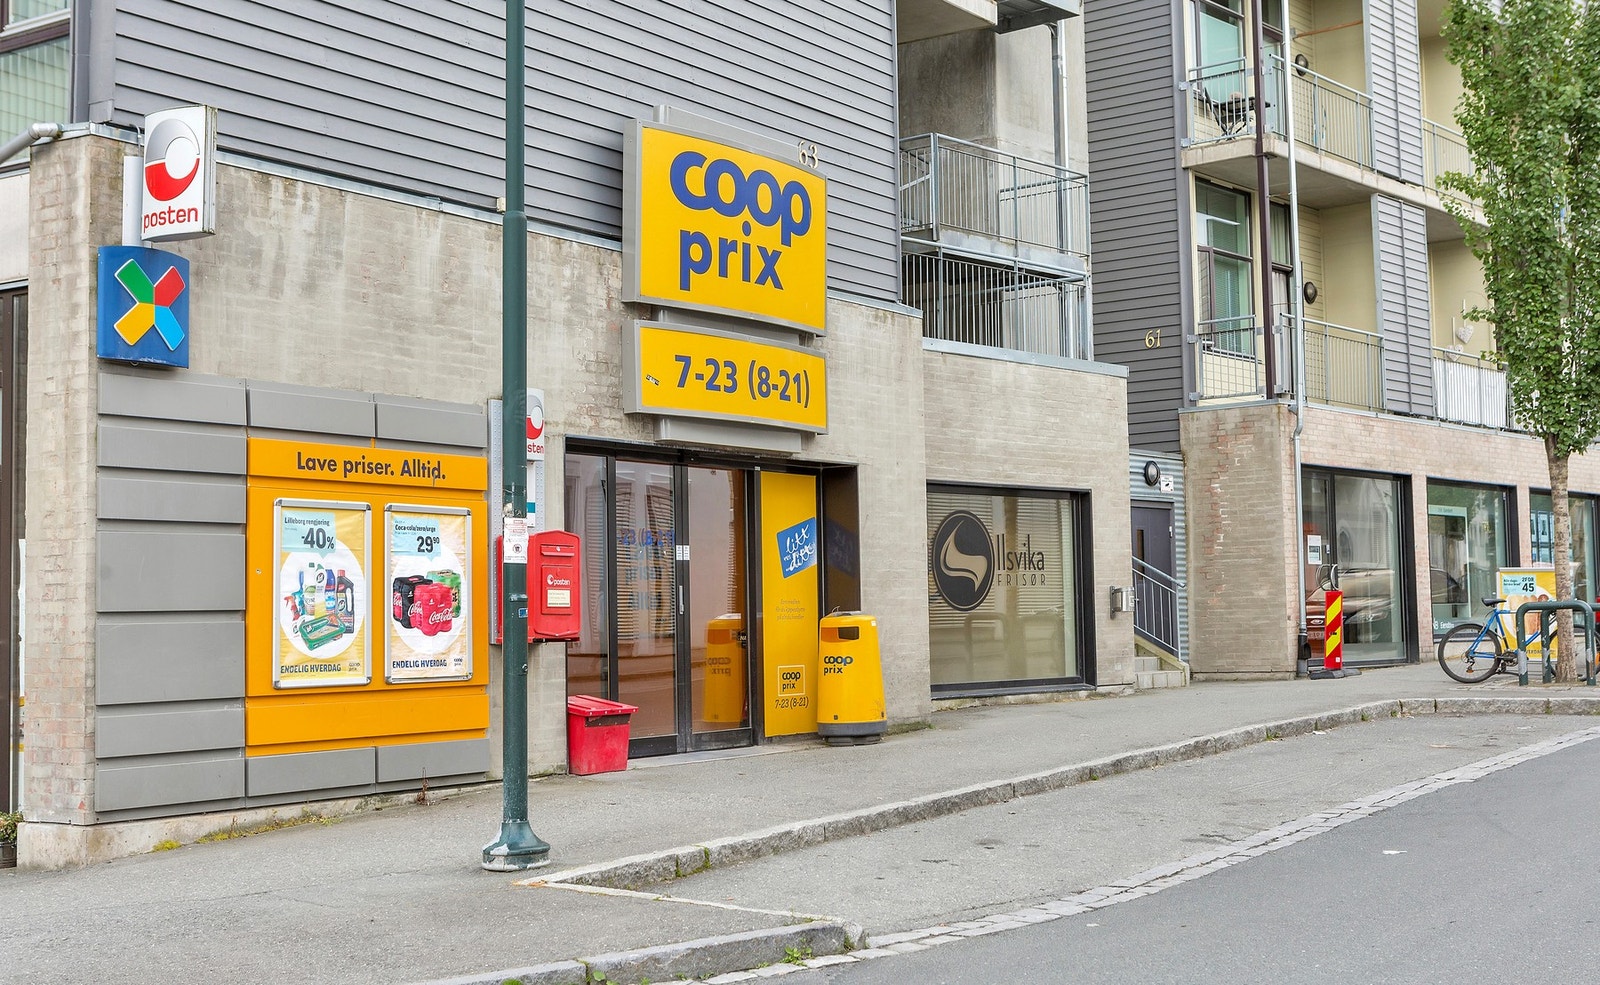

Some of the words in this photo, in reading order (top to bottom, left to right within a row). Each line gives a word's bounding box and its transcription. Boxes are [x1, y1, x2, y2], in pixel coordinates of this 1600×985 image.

[798, 140, 819, 169] 63
[669, 151, 812, 248] coop
[143, 206, 198, 233] posten
[679, 220, 784, 292] prix
[1144, 329, 1162, 349] 61
[674, 354, 738, 394] 7-23
[748, 360, 810, 409] (8-21)
[527, 442, 544, 454] sten
[296, 451, 337, 472] Lave
[343, 455, 395, 478] priser.
[400, 459, 446, 480] Alltid.
[301, 527, 335, 549] -40%
[997, 574, 1046, 586] FRISØR
[1522, 583, 1534, 592] 45
[392, 660, 420, 669] ENDELIG
[420, 659, 447, 668] HVERDAG
[824, 655, 854, 667] coop
[280, 665, 309, 673] ENDELIG
[310, 664, 341, 672] HVERDAG
[823, 664, 843, 676] prix
[782, 671, 801, 682] coop
[782, 680, 796, 692] prix
[775, 698, 790, 709] 7-23
[790, 696, 809, 709] (8-21)
